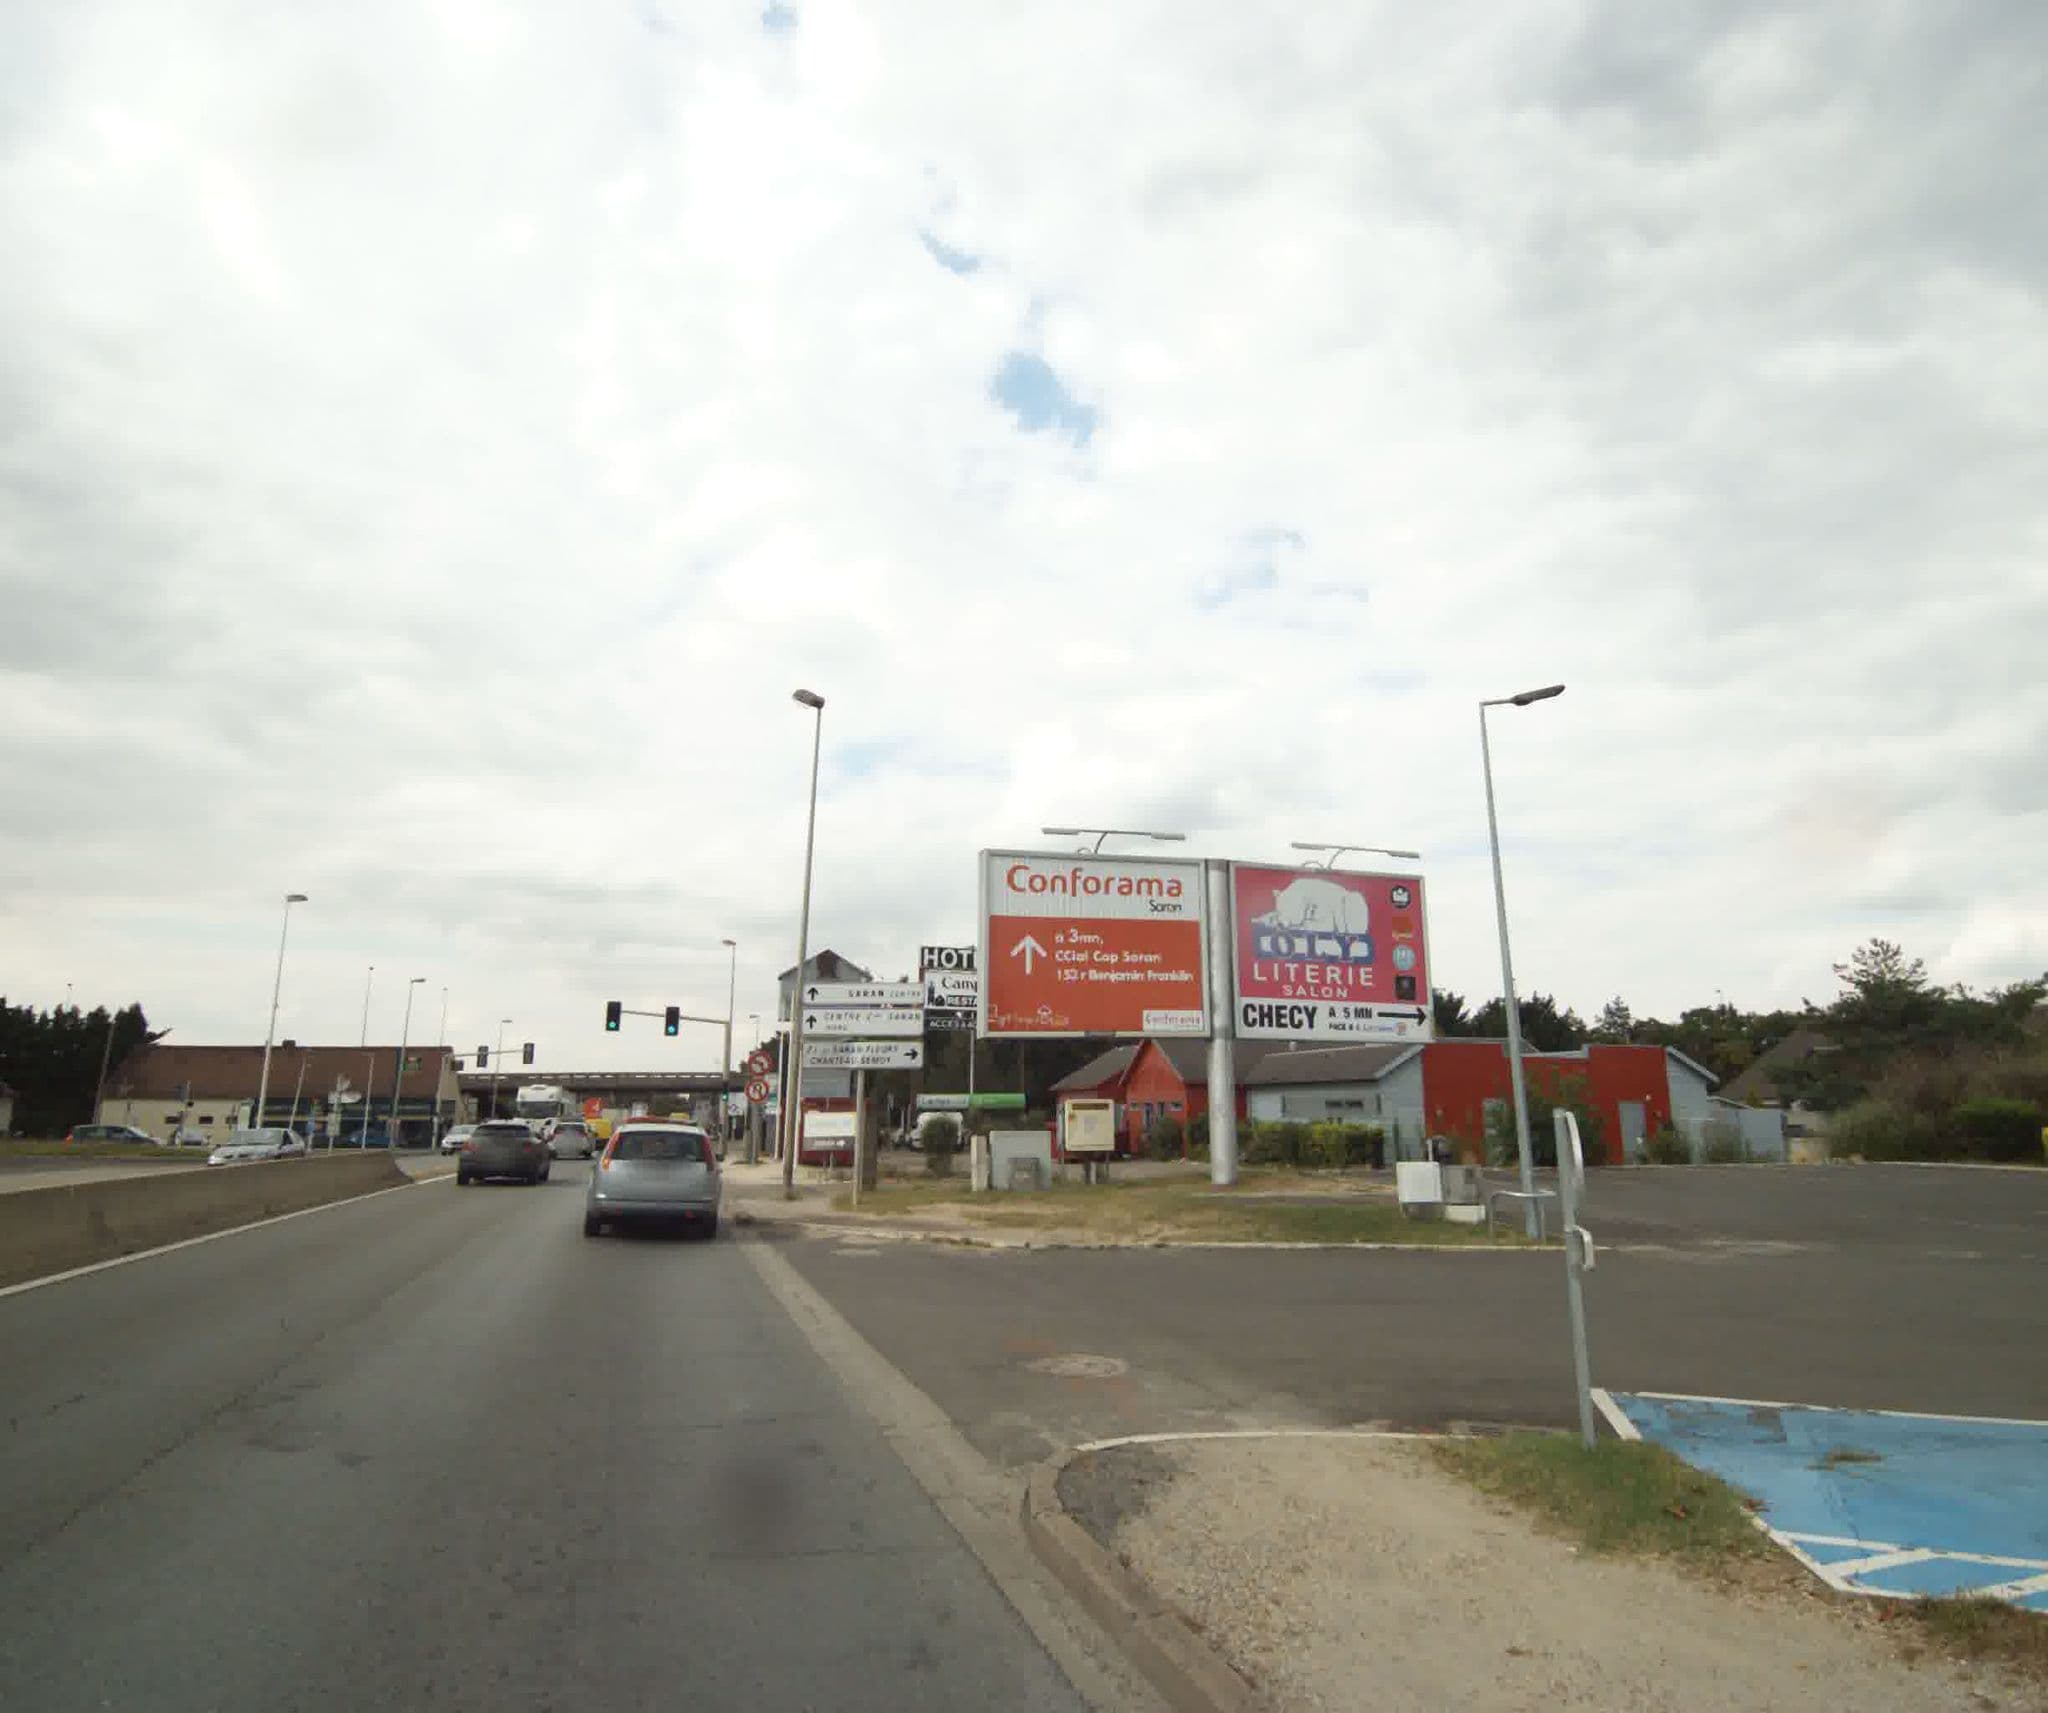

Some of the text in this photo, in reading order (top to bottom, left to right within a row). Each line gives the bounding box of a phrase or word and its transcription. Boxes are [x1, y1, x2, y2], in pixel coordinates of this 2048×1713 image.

[1006, 864, 1182, 897] Conforama
[1149, 899, 1182, 912] Saran
[923, 948, 977, 969] HOT
[1093, 950, 1119, 964] Cap
[1123, 950, 1162, 963] Saran
[1088, 969, 1144, 983] Benjamin
[1253, 961, 1374, 987] LITERIE
[848, 989, 885, 998] SARAN
[1282, 984, 1349, 998] SALON
[1242, 1003, 1373, 1030] CHECY A 5 MN
